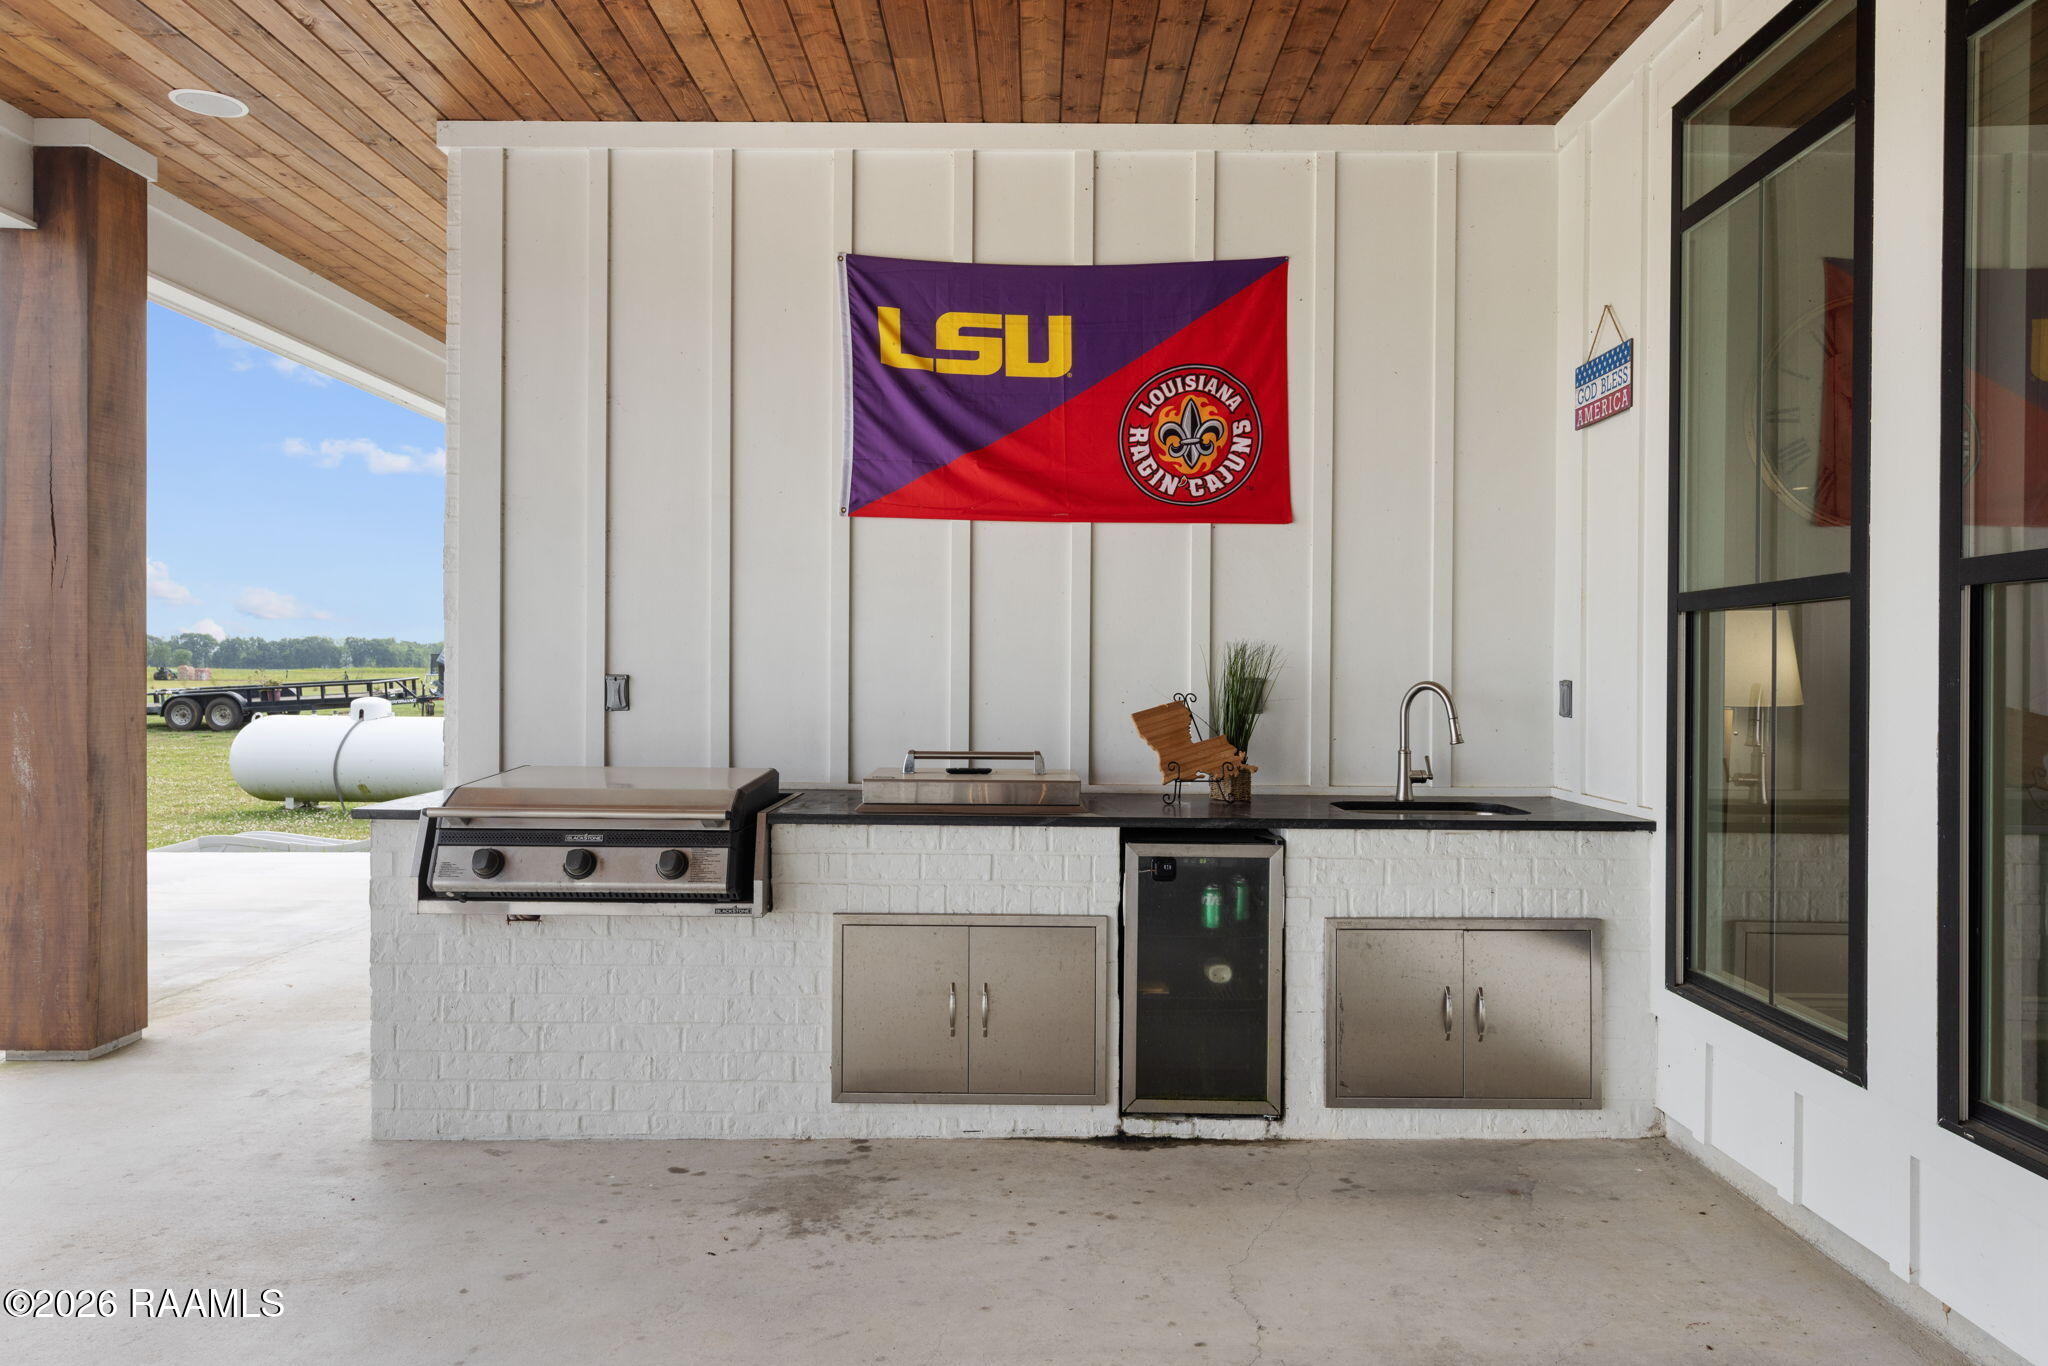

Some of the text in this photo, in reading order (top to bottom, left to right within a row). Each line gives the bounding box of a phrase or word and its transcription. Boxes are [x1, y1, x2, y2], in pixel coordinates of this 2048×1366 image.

[878, 305, 1073, 378] LSU
[1138, 374, 1243, 417] LOUISIANA
[1577, 365, 1629, 405] GOD BLESS
[1576, 388, 1629, 427] AMERICA
[1189, 418, 1253, 497] CAJUNS
[565, 834, 603, 842] BLACKSTONE
[714, 906, 752, 914] BLACKSTONE
